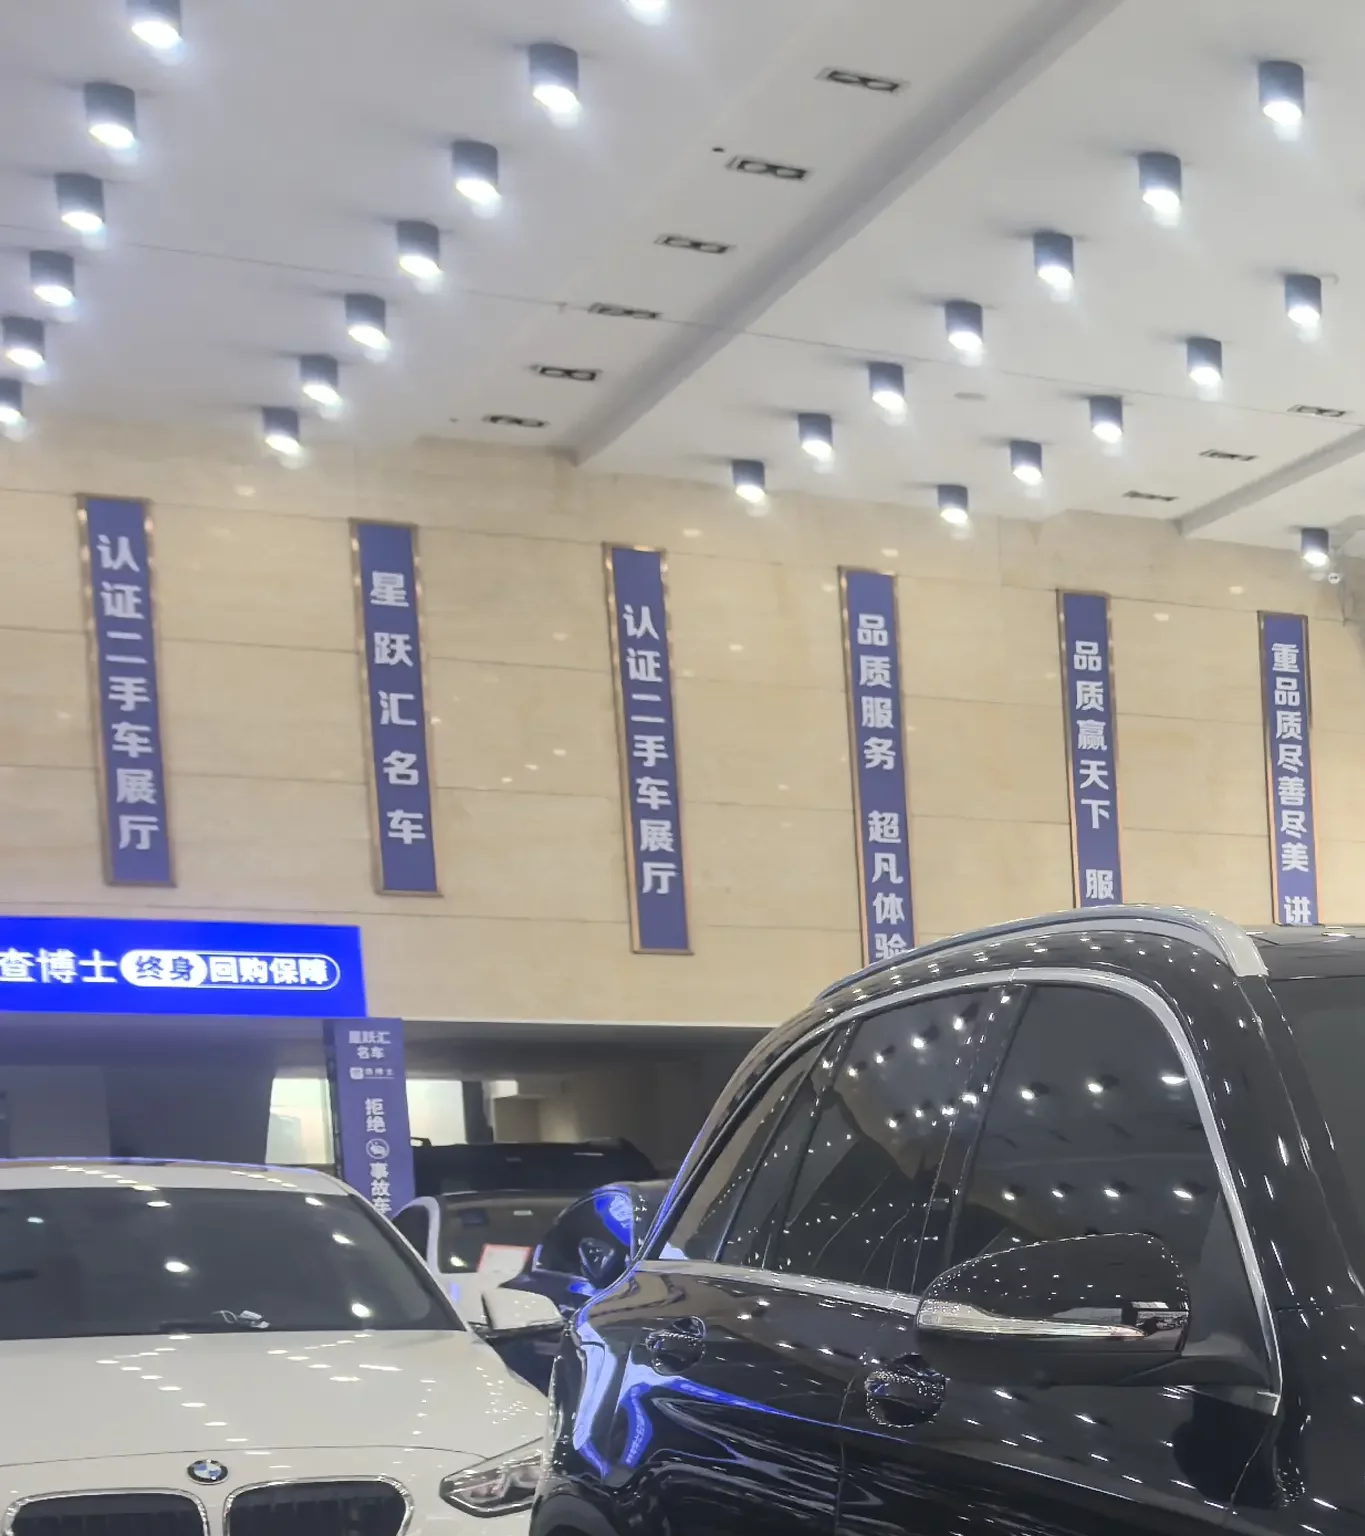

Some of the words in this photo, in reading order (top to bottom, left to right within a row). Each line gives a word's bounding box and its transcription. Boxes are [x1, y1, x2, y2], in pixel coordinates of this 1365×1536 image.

[98, 535, 160, 851] 认证二手车展厅
[370, 571, 426, 843] 星跃汇名车
[624, 605, 678, 894] 认证二手车展厅
[856, 614, 896, 771] 品质服务
[1073, 641, 1110, 829] 品质赢天下
[1271, 643, 1309, 872] 重品质尽善尽美
[0, 948, 118, 984] 查博士
